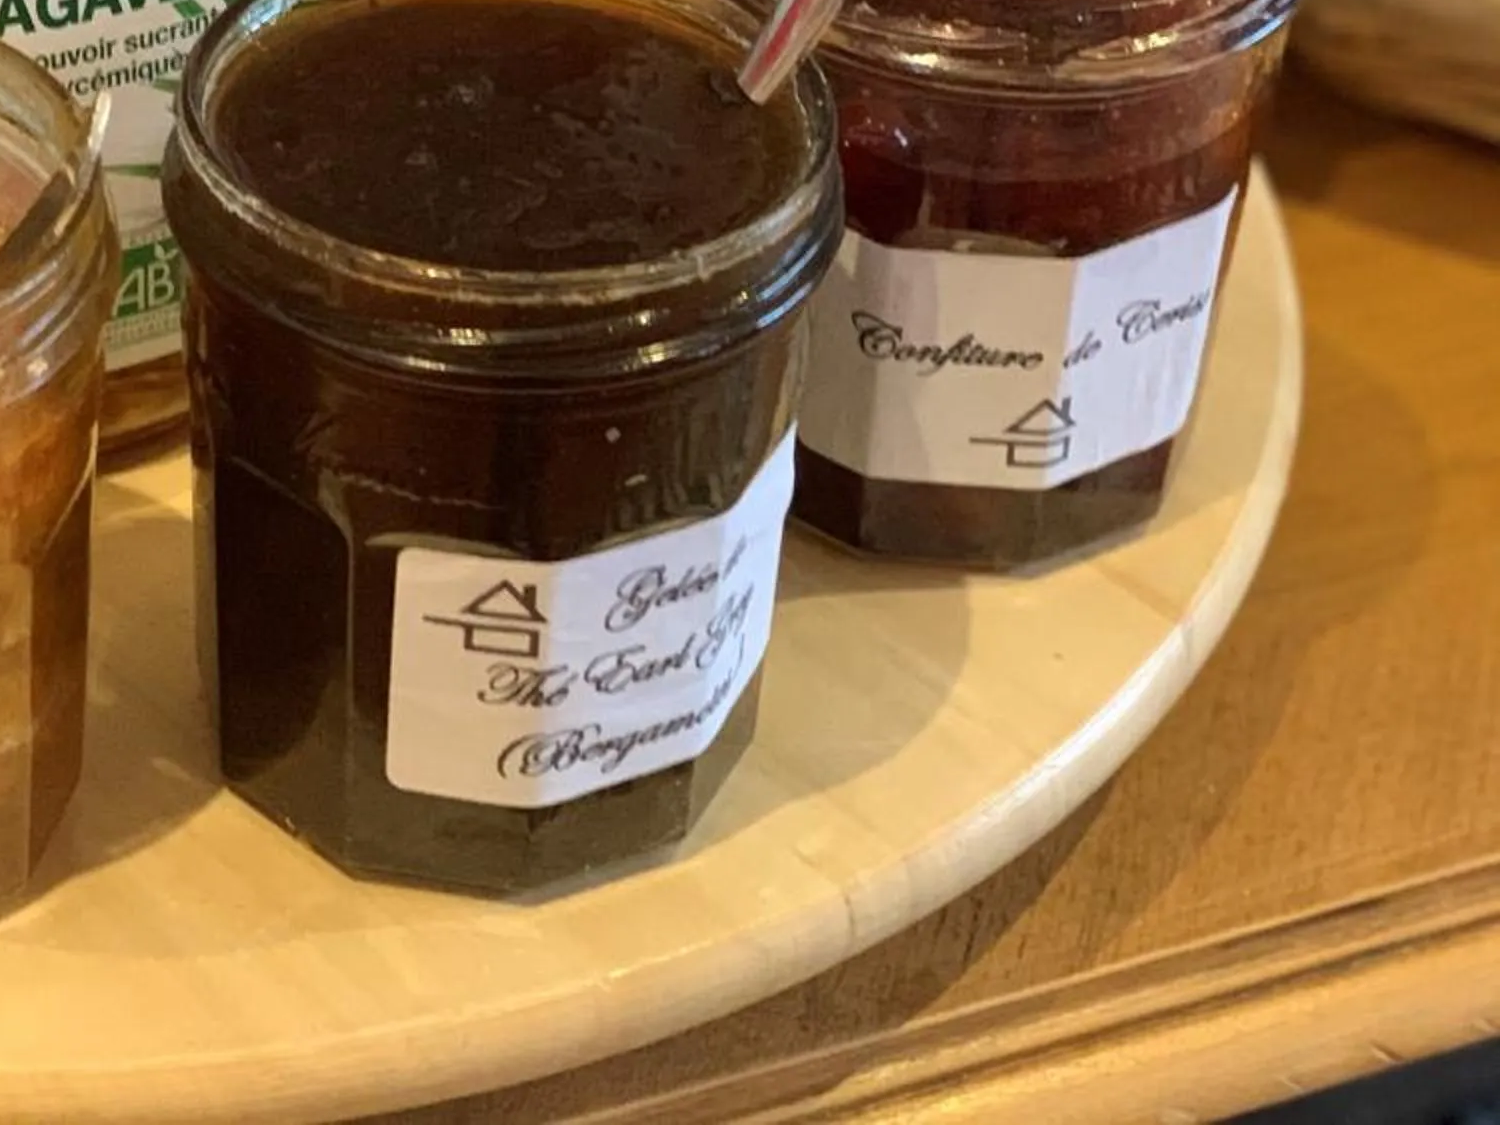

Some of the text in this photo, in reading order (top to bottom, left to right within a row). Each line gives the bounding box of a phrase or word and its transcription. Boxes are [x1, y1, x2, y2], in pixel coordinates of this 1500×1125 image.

[35, 38, 117, 71] ouvoir
[112, 262, 175, 318] AB
[851, 311, 1044, 377] Confiture
[1062, 330, 1102, 370] de
[476, 663, 580, 708] Thé
[584, 634, 695, 695] Earl
